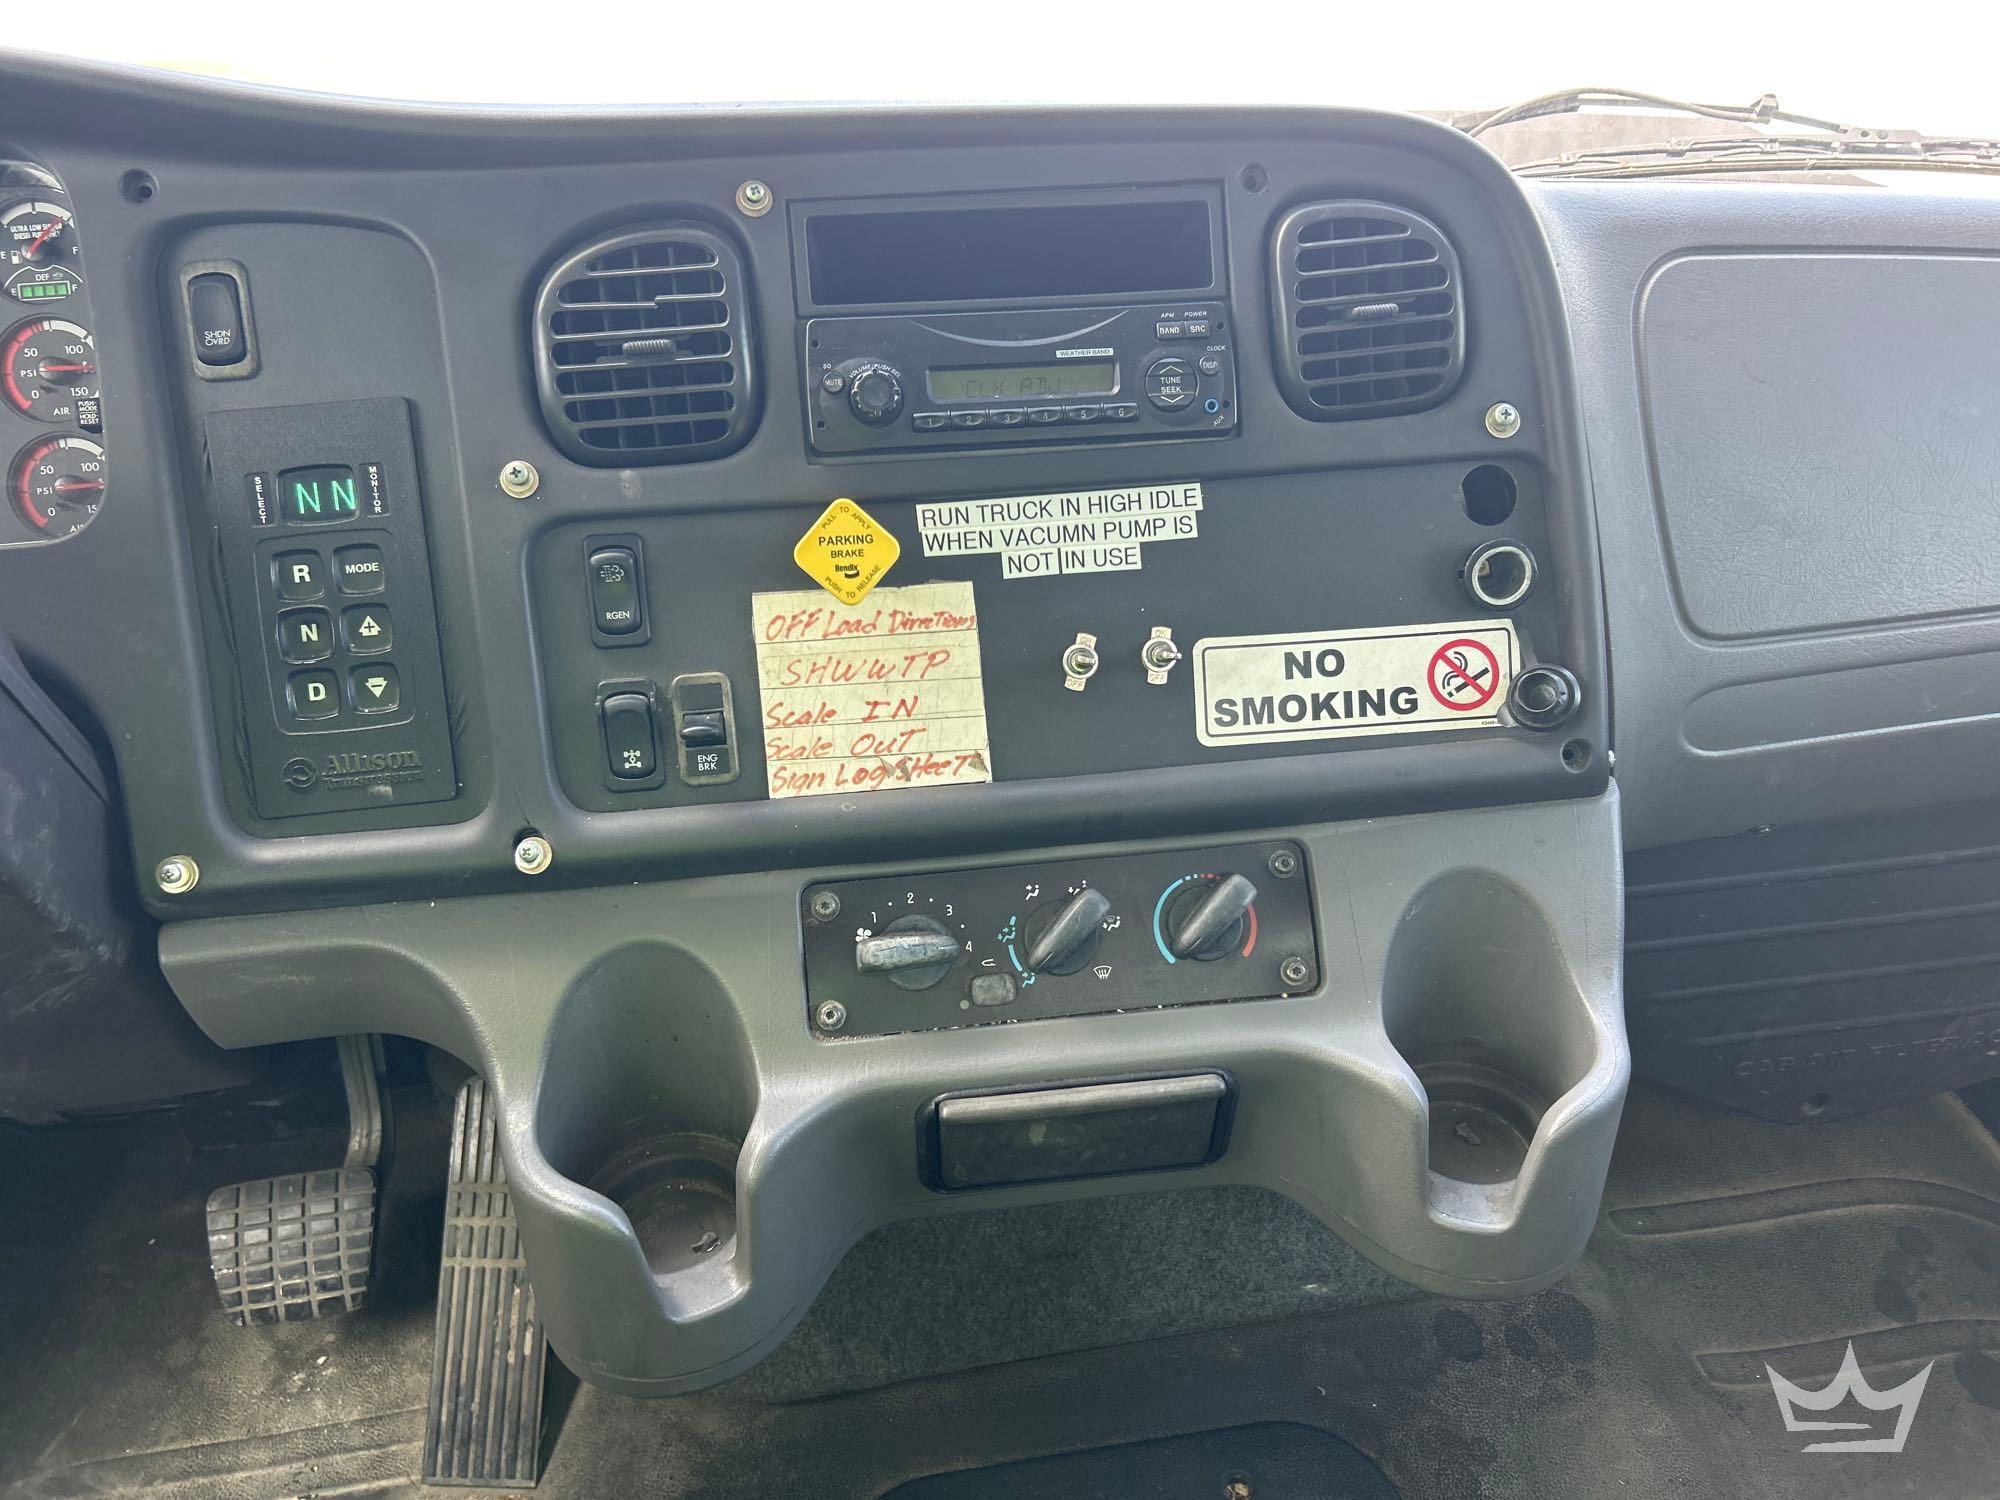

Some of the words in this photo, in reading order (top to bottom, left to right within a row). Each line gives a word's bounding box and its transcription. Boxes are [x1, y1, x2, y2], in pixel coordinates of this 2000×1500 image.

[1, 251, 6, 259] E
[72, 247, 78, 255] F
[11, 288, 17, 296] E
[1159, 327, 1180, 335] BAND
[1190, 325, 1206, 333] SRC
[204, 330, 231, 339] SHDN
[204, 338, 231, 346] OVRD
[24, 348, 38, 357] 50
[65, 345, 83, 354] 100
[1202, 361, 1218, 369] DISP
[20, 369, 37, 377] PSI
[1160, 376, 1181, 385] TUNE
[32, 390, 39, 399] 0
[71, 387, 88, 396] 150
[1161, 386, 1182, 394] SEEK
[53, 407, 70, 415] AIR
[1213, 414, 1225, 427] AUX
[40, 465, 54, 474] 50
[80, 462, 99, 471] 100
[37, 487, 53, 495] PSI
[368, 466, 382, 513] MONITOR
[254, 477, 267, 524] SELECT
[296, 482, 321, 514] N
[331, 479, 356, 510] N
[48, 507, 55, 516] 0
[921, 506, 970, 528] RUN
[976, 500, 1054, 524] TRUCK
[1059, 496, 1081, 517] IN
[1088, 491, 1142, 515] HIGH
[1149, 487, 1198, 510] IDLE
[821, 514, 837, 530] PULL
[850, 512, 872, 531] APPLY
[925, 529, 993, 552] WHEN
[1000, 522, 1096, 548] VACUMN
[1103, 517, 1167, 541] PUMP
[1174, 515, 1194, 536] IS
[818, 533, 874, 547] PARKING
[830, 549, 865, 559] BRAKE
[1007, 551, 1054, 574] NOT
[1065, 549, 1086, 569] IN
[1092, 546, 1138, 567] USE
[345, 563, 380, 574] MODE
[834, 563, 858, 572] Bendix
[293, 565, 311, 583] R
[825, 576, 843, 593] PUSH
[845, 591, 856, 599] TO
[856, 564, 882, 592] RELEASE
[606, 611, 630, 620] RGEN
[300, 623, 319, 642] N
[1283, 648, 1346, 680] NO
[308, 682, 326, 701] D
[1213, 685, 1419, 728] SMOKING
[766, 700, 838, 729] Scale
[862, 695, 919, 723] IN
[767, 736, 834, 761] Scale
[697, 753, 718, 762] ENG
[322, 751, 422, 775] Allison
[698, 762, 717, 771] BRK
[772, 765, 826, 795] Sign
[907, 892, 915, 904] 2
[945, 904, 953, 916] 3
[871, 911, 877, 923] 1
[965, 940, 973, 952] 4
